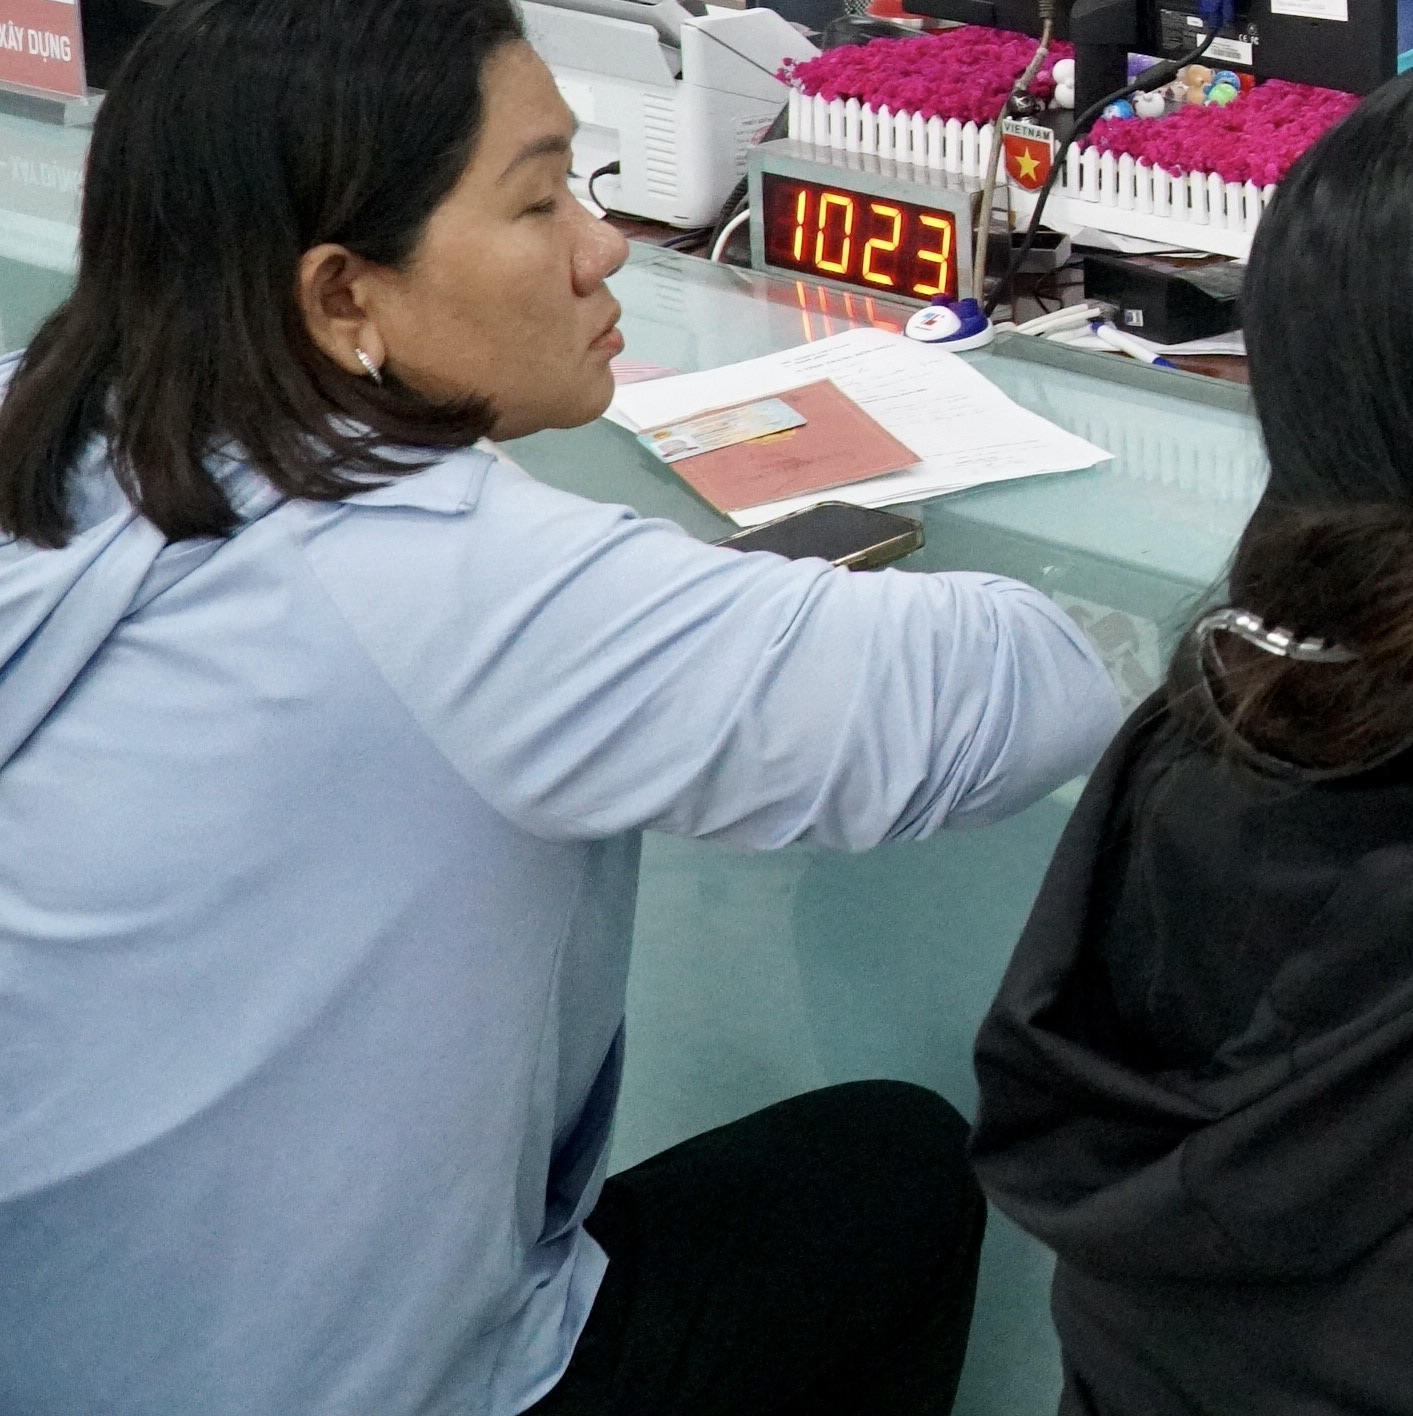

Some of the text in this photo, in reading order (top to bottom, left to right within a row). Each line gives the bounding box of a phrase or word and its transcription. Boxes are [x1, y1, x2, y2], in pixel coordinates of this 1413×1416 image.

[28, 29, 72, 63] DỰNG
[1005, 123, 1050, 141] VIETNAM
[793, 188, 952, 296] 1023
